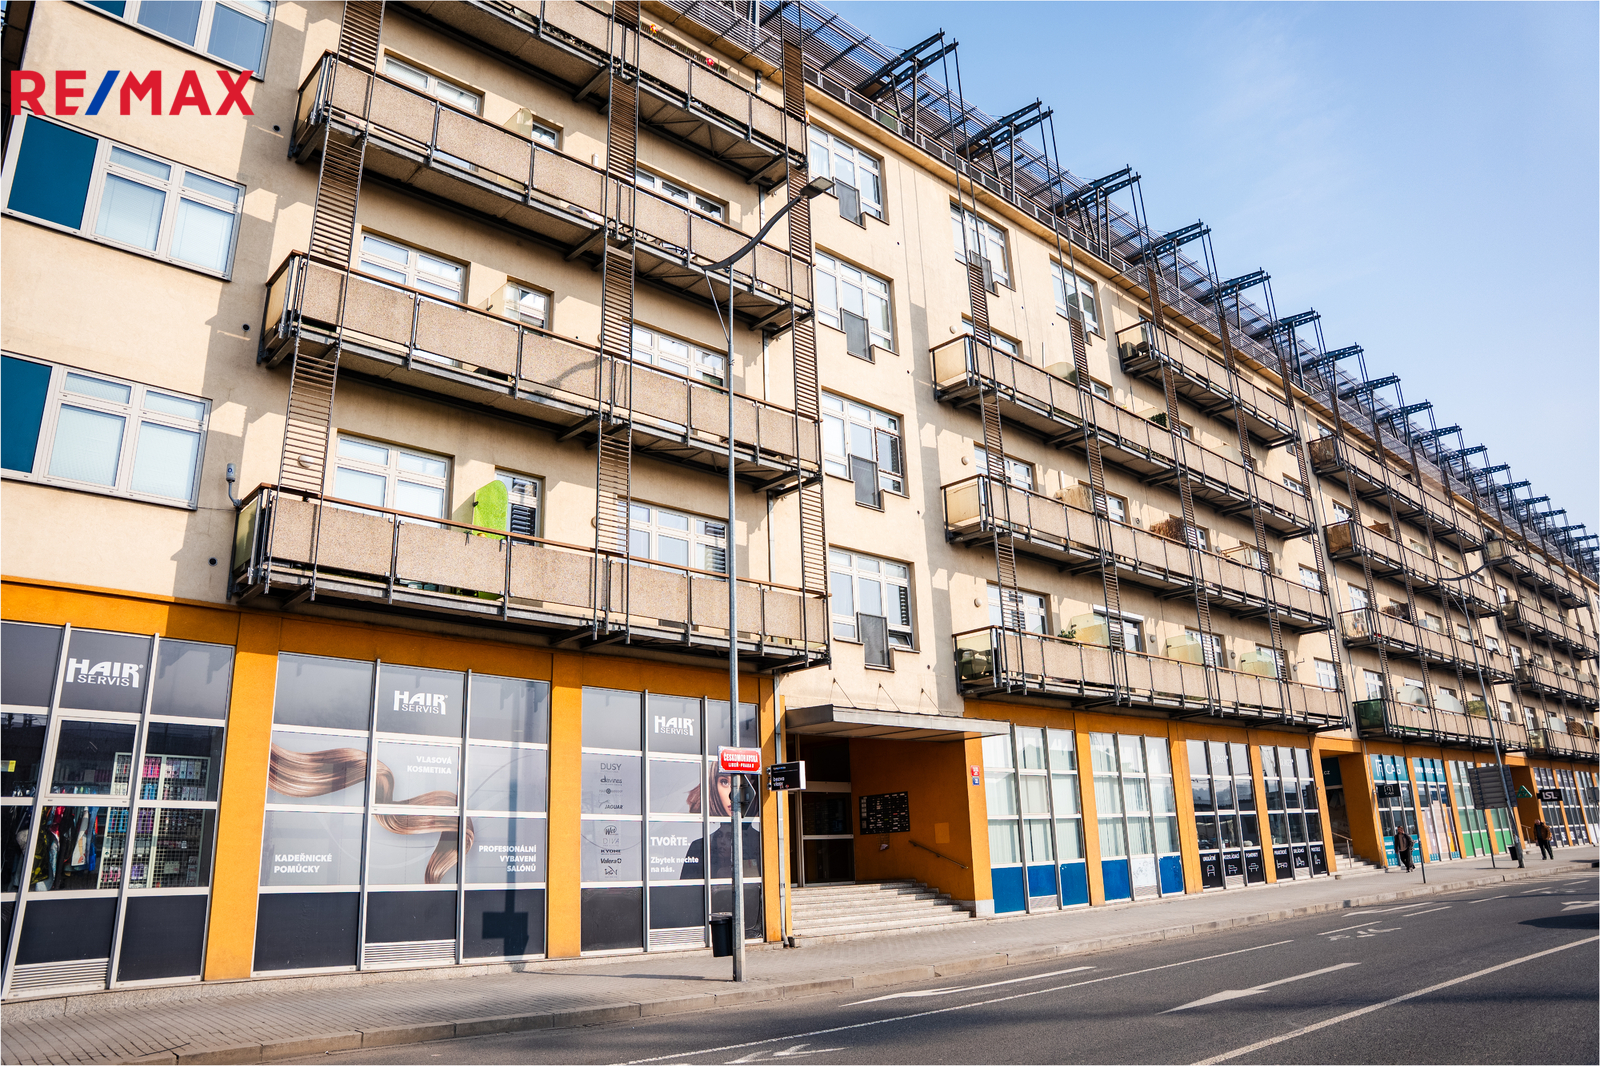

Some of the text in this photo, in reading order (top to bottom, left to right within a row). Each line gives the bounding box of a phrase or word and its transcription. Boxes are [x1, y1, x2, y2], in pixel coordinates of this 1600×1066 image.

[66, 657, 140, 689] HAIR
[77, 674, 130, 687] SERVIS
[393, 690, 446, 715] HAIR
[401, 703, 439, 714] SERVIS
[654, 715, 694, 736] HAIR
[660, 727, 689, 735] SERVIS
[416, 755, 452, 765] VLASOVÁ
[407, 765, 452, 774] KOSMETIKA
[600, 763, 622, 771] DUSY
[650, 835, 690, 846] TVOŘTE.
[478, 844, 537, 853] PROFESIONÁLNÍ
[274, 852, 333, 862] KADEŘNICKÉ
[499, 854, 537, 862] VYBAVENÍ
[650, 856, 675, 865] Zbytek
[273, 863, 320, 873] POMŮCKY
[506, 863, 536, 872] SALÓNŮ
